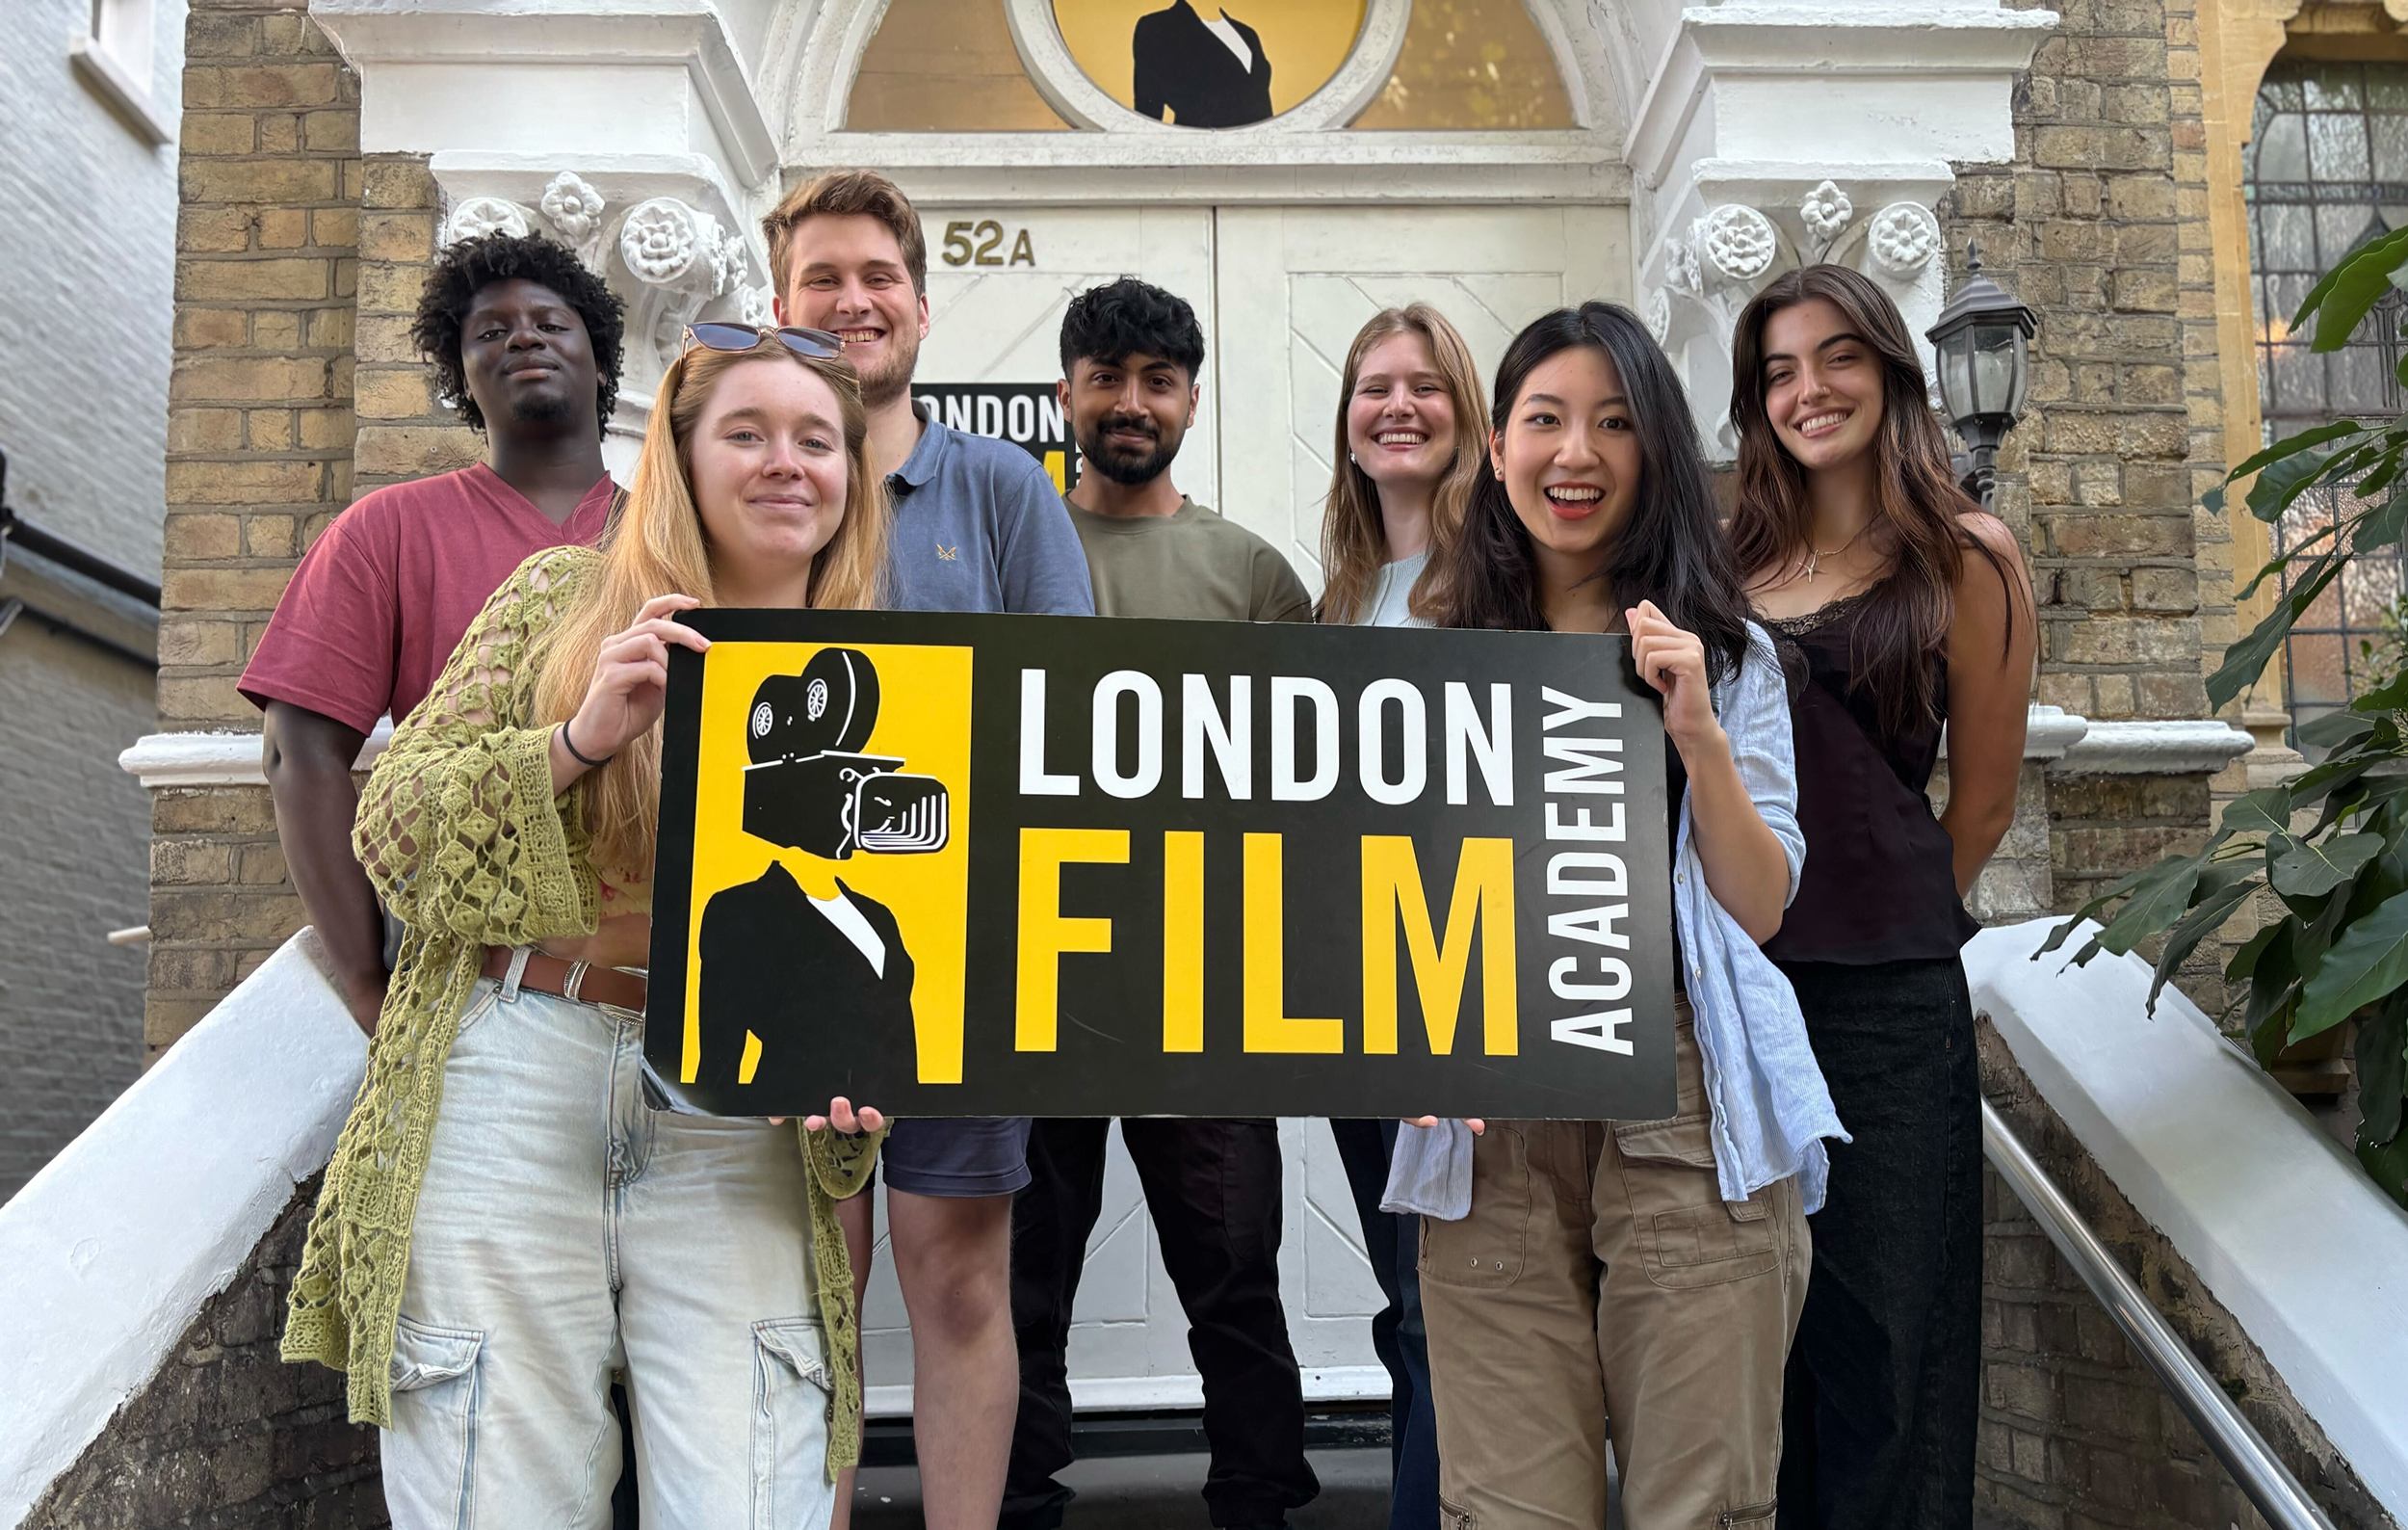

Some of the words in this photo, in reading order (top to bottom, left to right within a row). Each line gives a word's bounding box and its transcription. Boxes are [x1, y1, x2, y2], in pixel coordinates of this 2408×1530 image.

[941, 220, 1035, 267] 52A
[917, 394, 1065, 442] NDON
[1018, 668, 1515, 806] LONDON
[1541, 685, 1635, 1057] ACADEMY
[1014, 827, 1519, 1057] FILM
